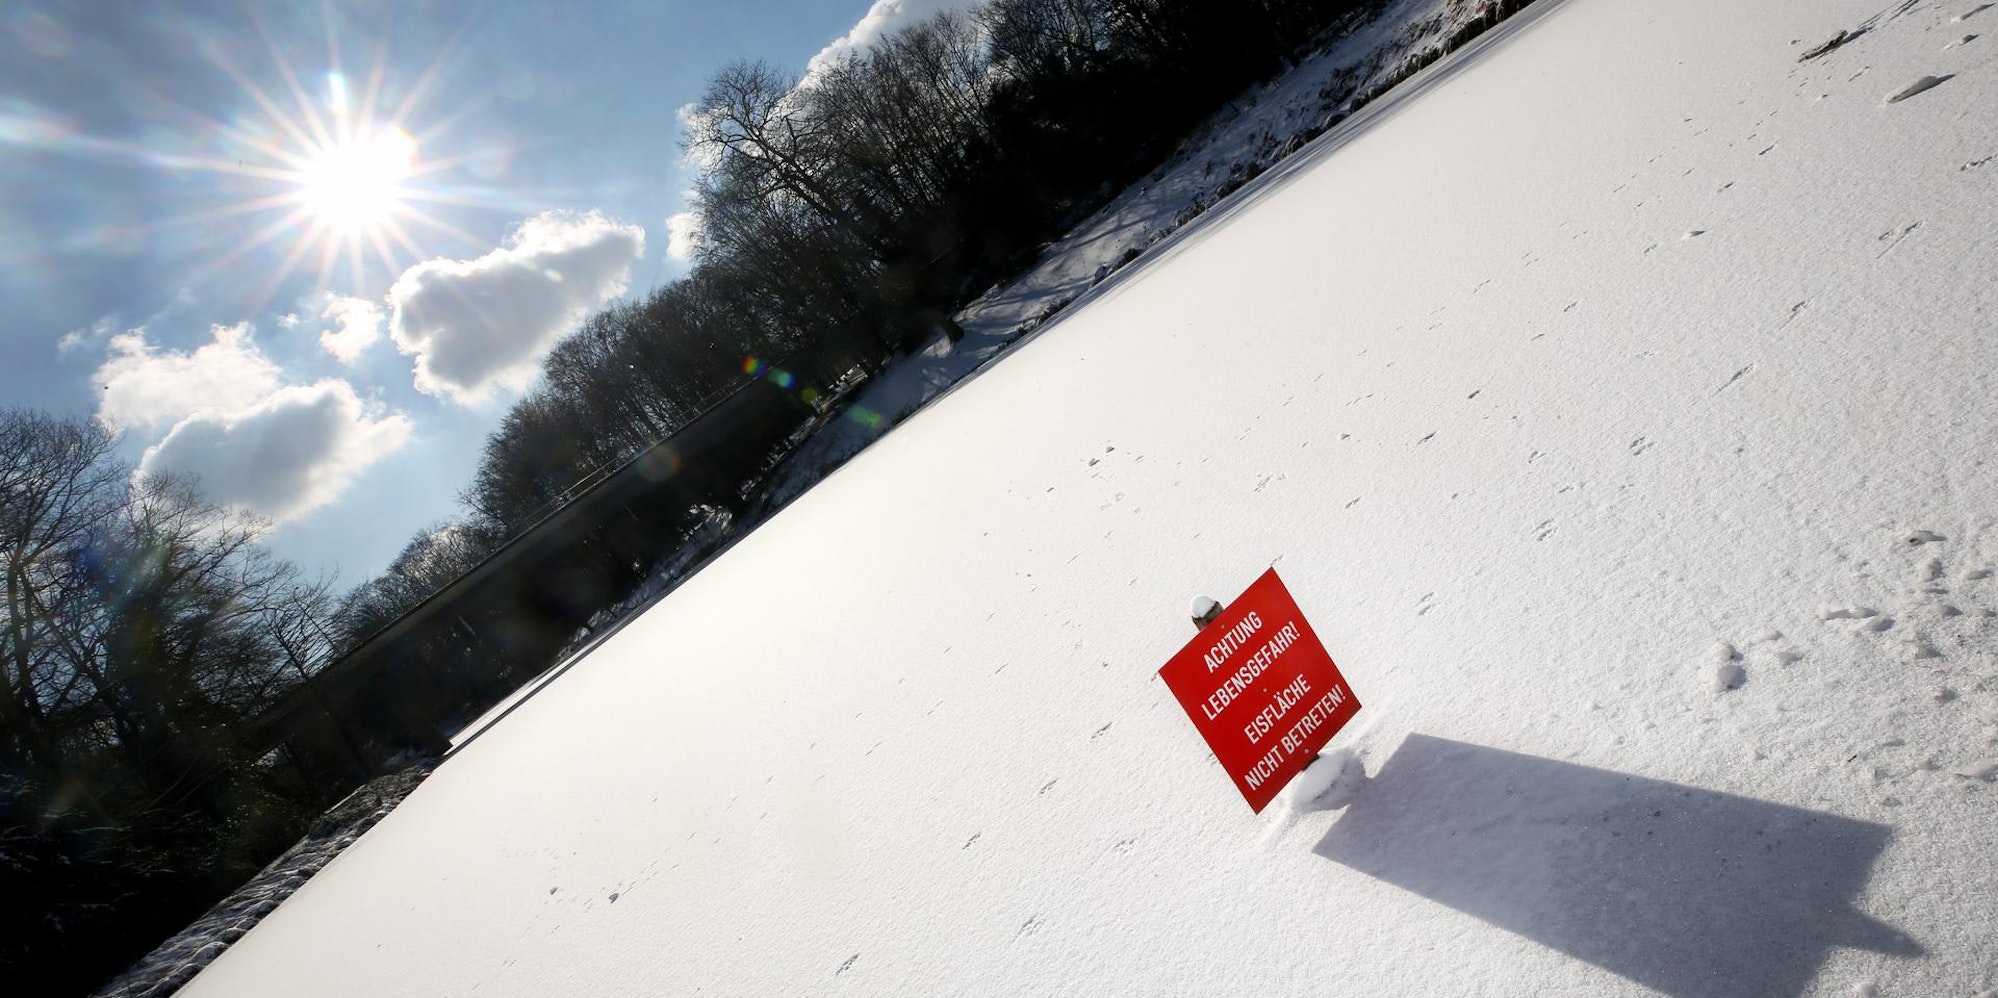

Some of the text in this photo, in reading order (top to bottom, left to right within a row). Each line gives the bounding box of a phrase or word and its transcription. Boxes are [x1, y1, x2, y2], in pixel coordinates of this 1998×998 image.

[1201, 620, 1301, 721] LEBENSGEFAHR!
[1203, 611, 1263, 674] ACHTUNG
[1243, 673, 1312, 745] EISFLÄCHE
[1244, 684, 1347, 791] NICHT BETRETEN!
